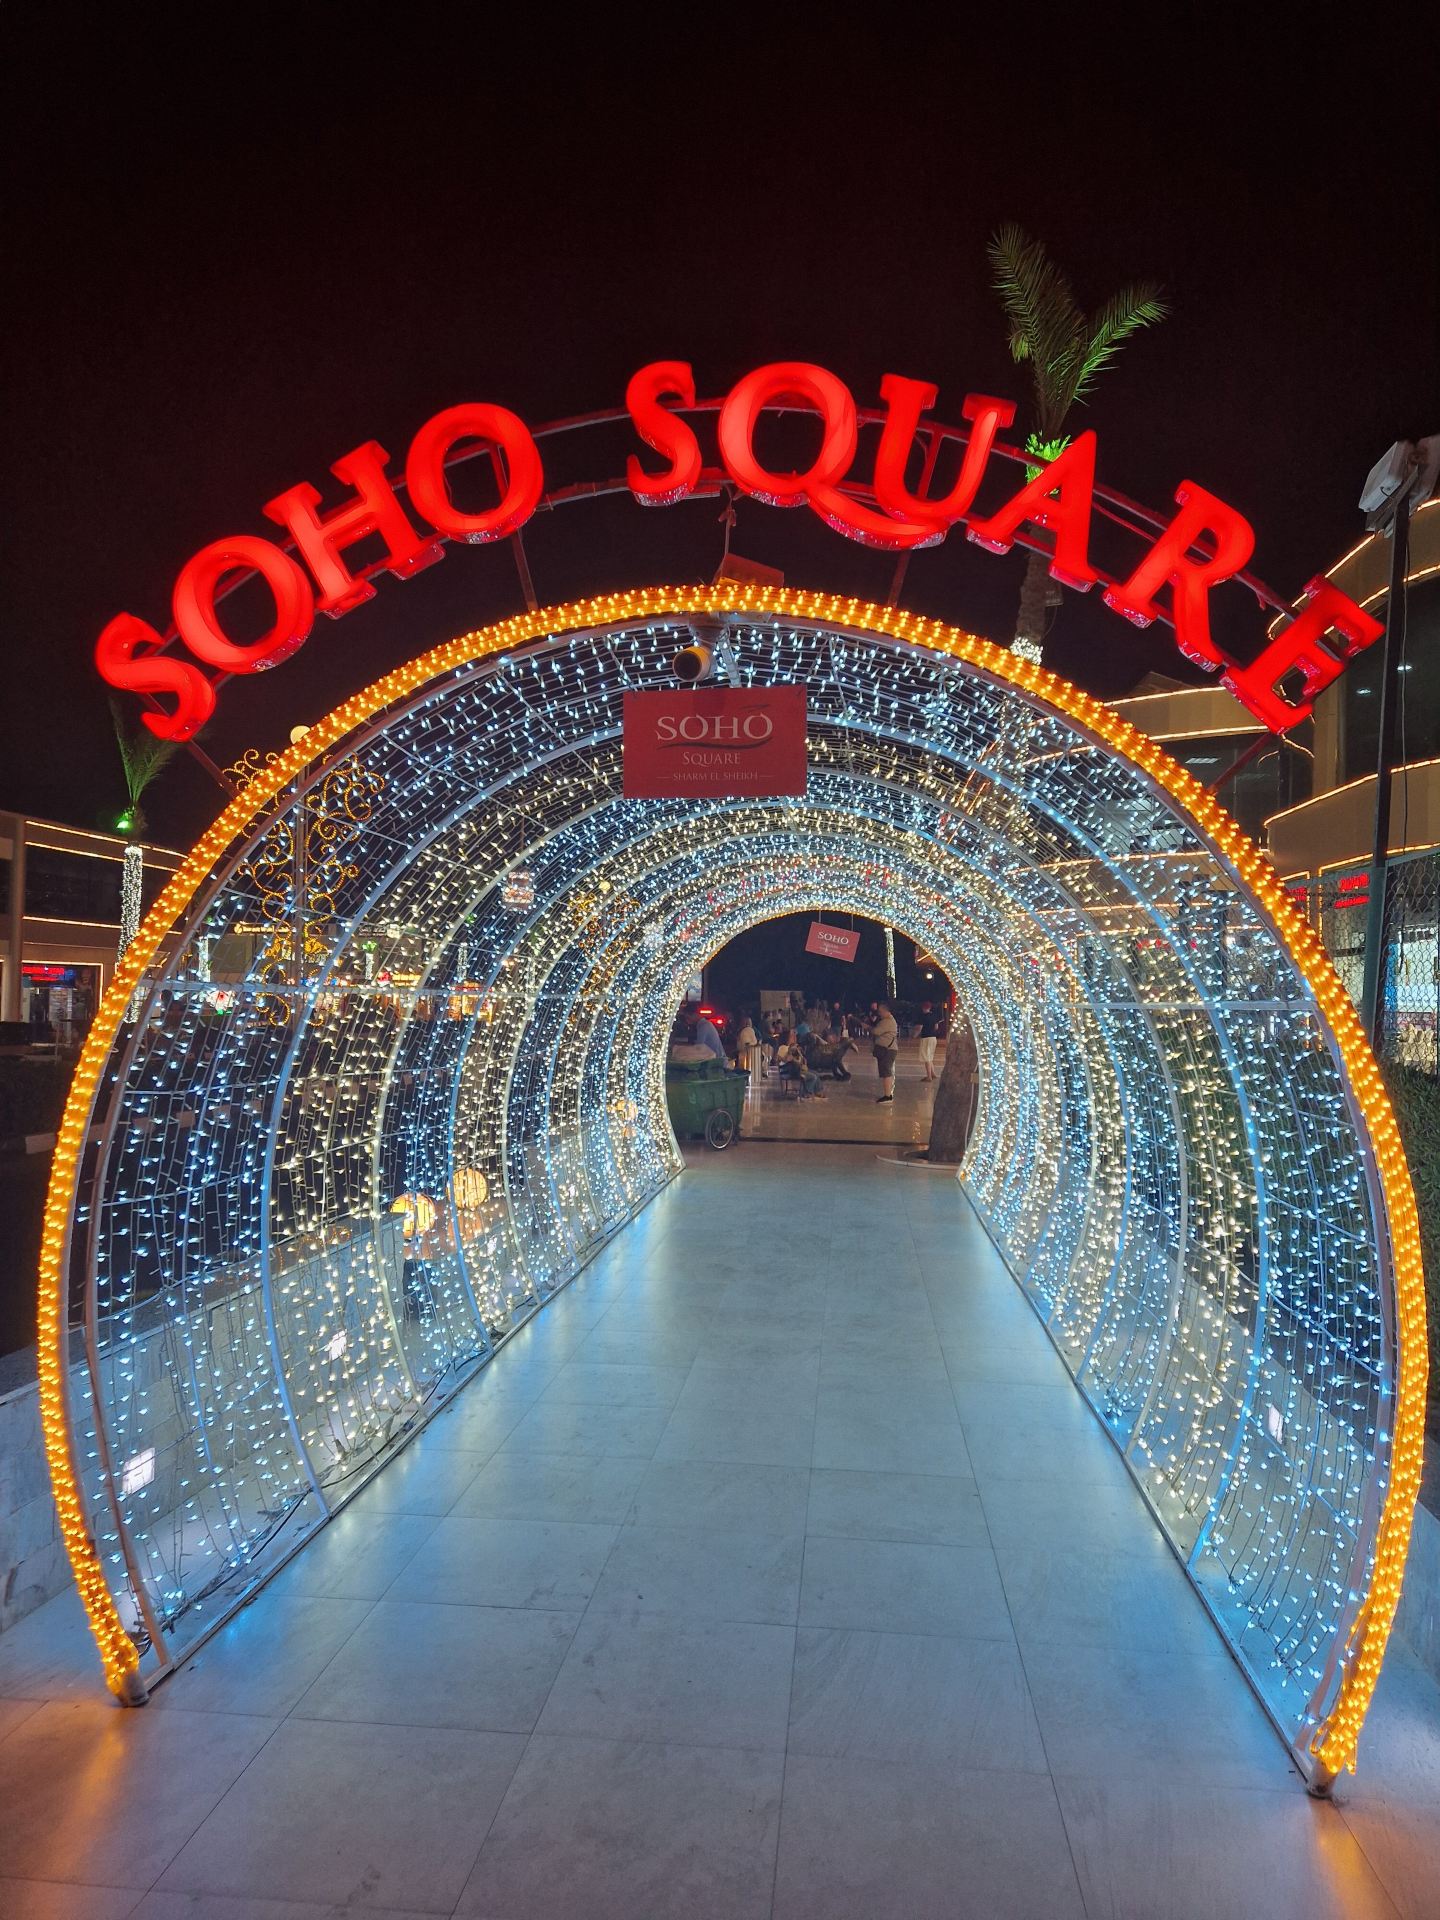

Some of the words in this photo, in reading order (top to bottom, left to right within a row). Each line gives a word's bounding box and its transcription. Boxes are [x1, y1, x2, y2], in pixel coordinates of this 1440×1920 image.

[95, 402, 544, 742] SOHO
[626, 360, 1386, 735] SQUARE
[656, 713, 773, 740] SOHO
[682, 752, 741, 767] SQUARE
[673, 772, 707, 781] SHARM
[710, 772, 720, 781] EL
[724, 771, 758, 781] SHEIKH
[817, 931, 849, 945] SOHO
